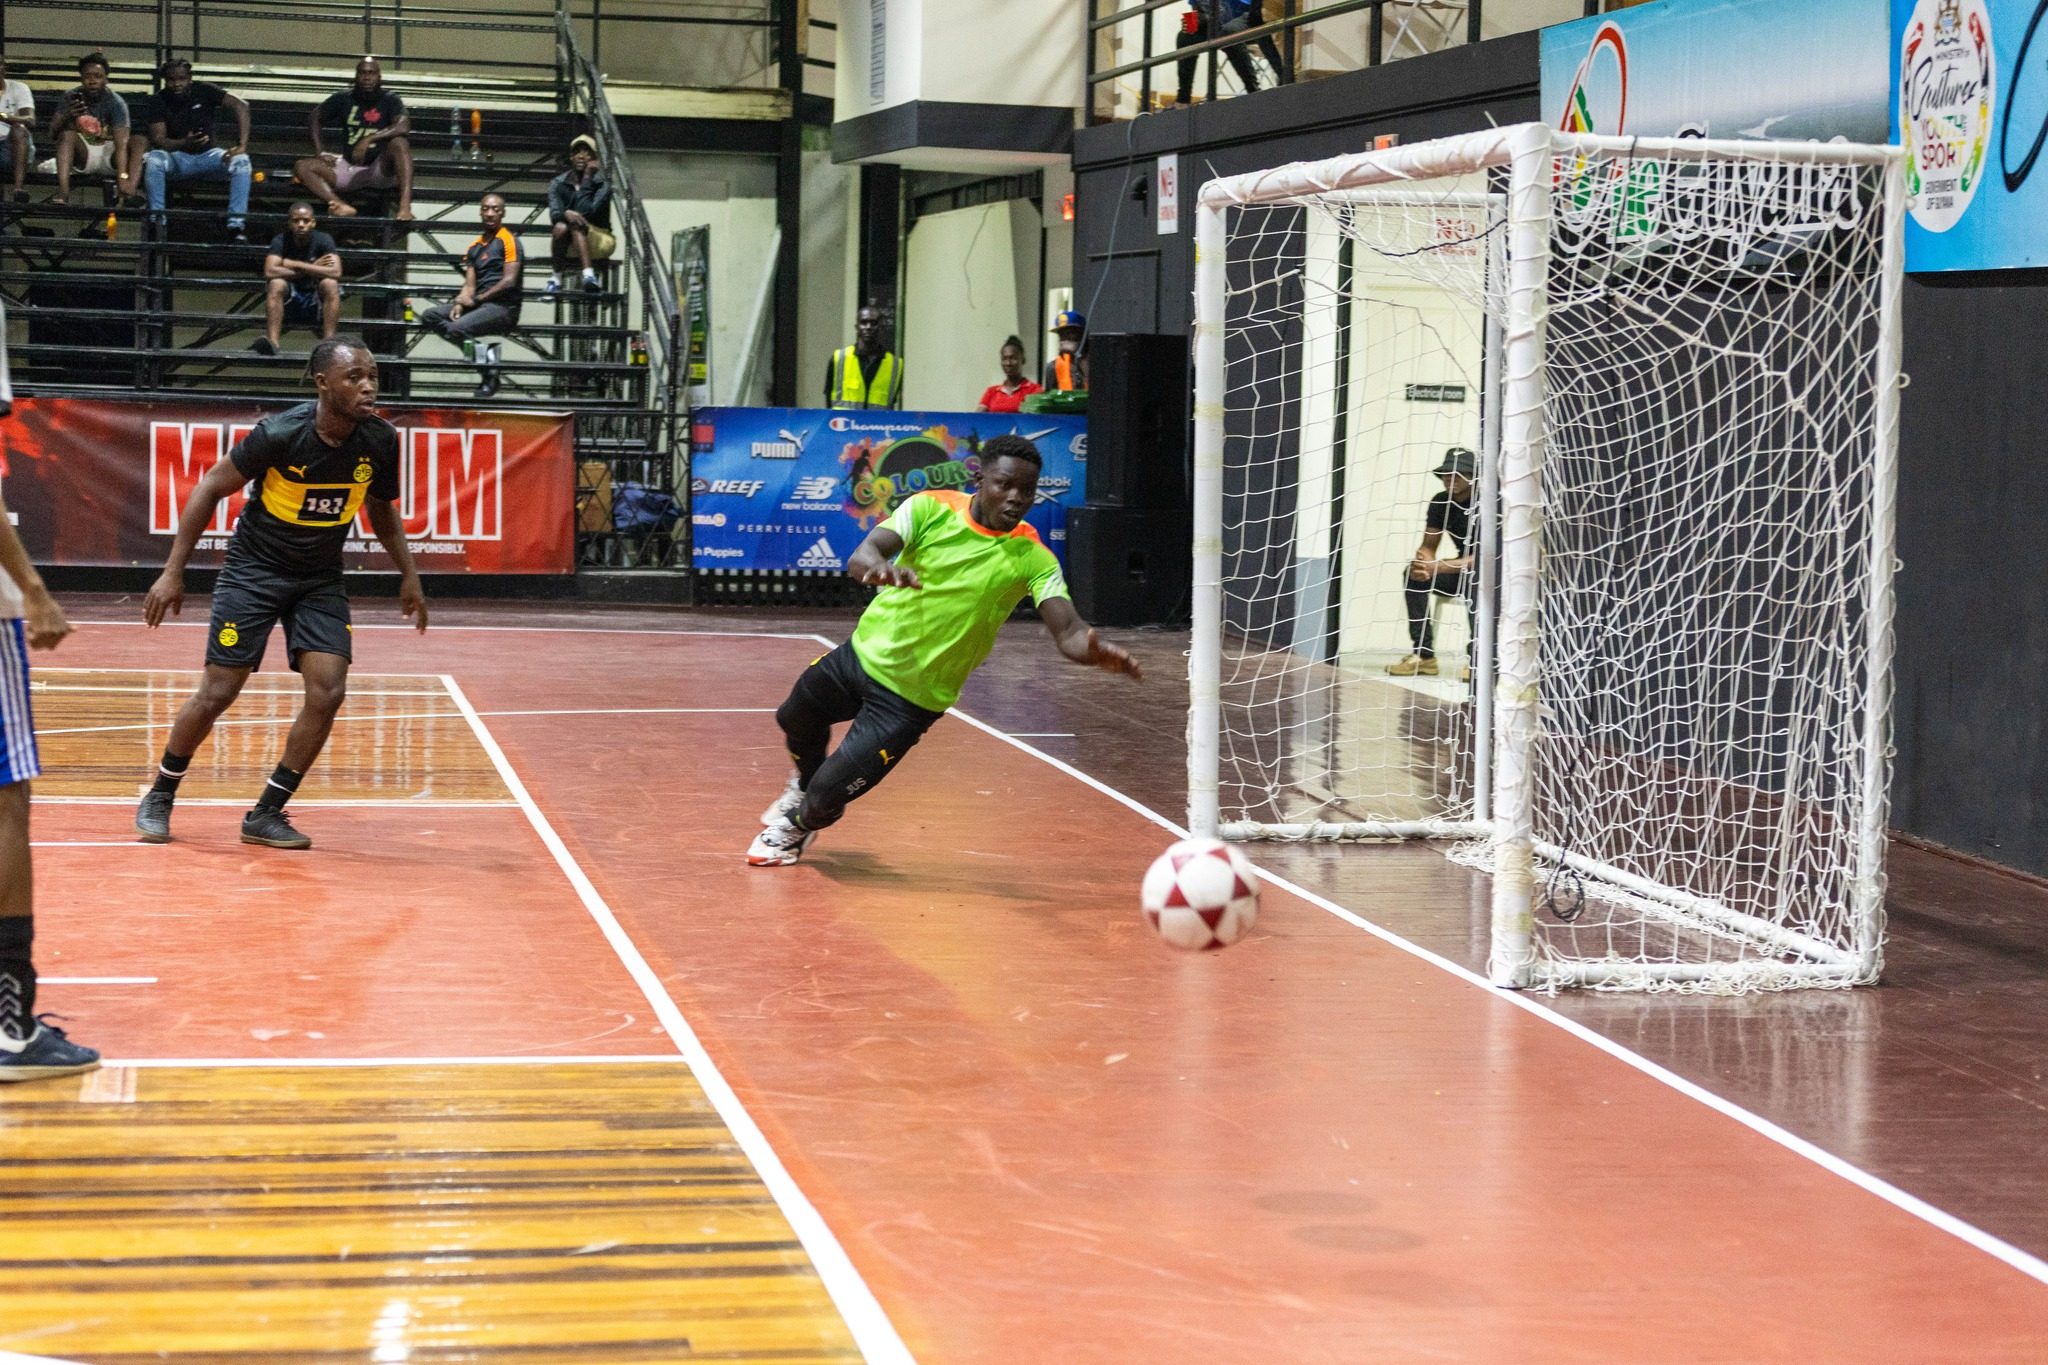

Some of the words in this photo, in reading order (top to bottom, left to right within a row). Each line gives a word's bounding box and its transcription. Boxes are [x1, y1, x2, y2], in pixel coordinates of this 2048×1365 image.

[1921, 140, 1967, 171] SPORT
[751, 442, 799, 459] PUMA
[854, 455, 982, 506] COLOURS
[1037, 476, 1072, 487] ebok
[709, 480, 765, 498] REEF
[781, 502, 801, 511] new
[802, 502, 843, 512] balance
[738, 524, 782, 533] PERRY
[786, 525, 827, 534] ELLIS
[406, 542, 467, 555] ESPONSIBLY.
[704, 547, 745, 558] Puppies
[796, 556, 842, 568] adidas
